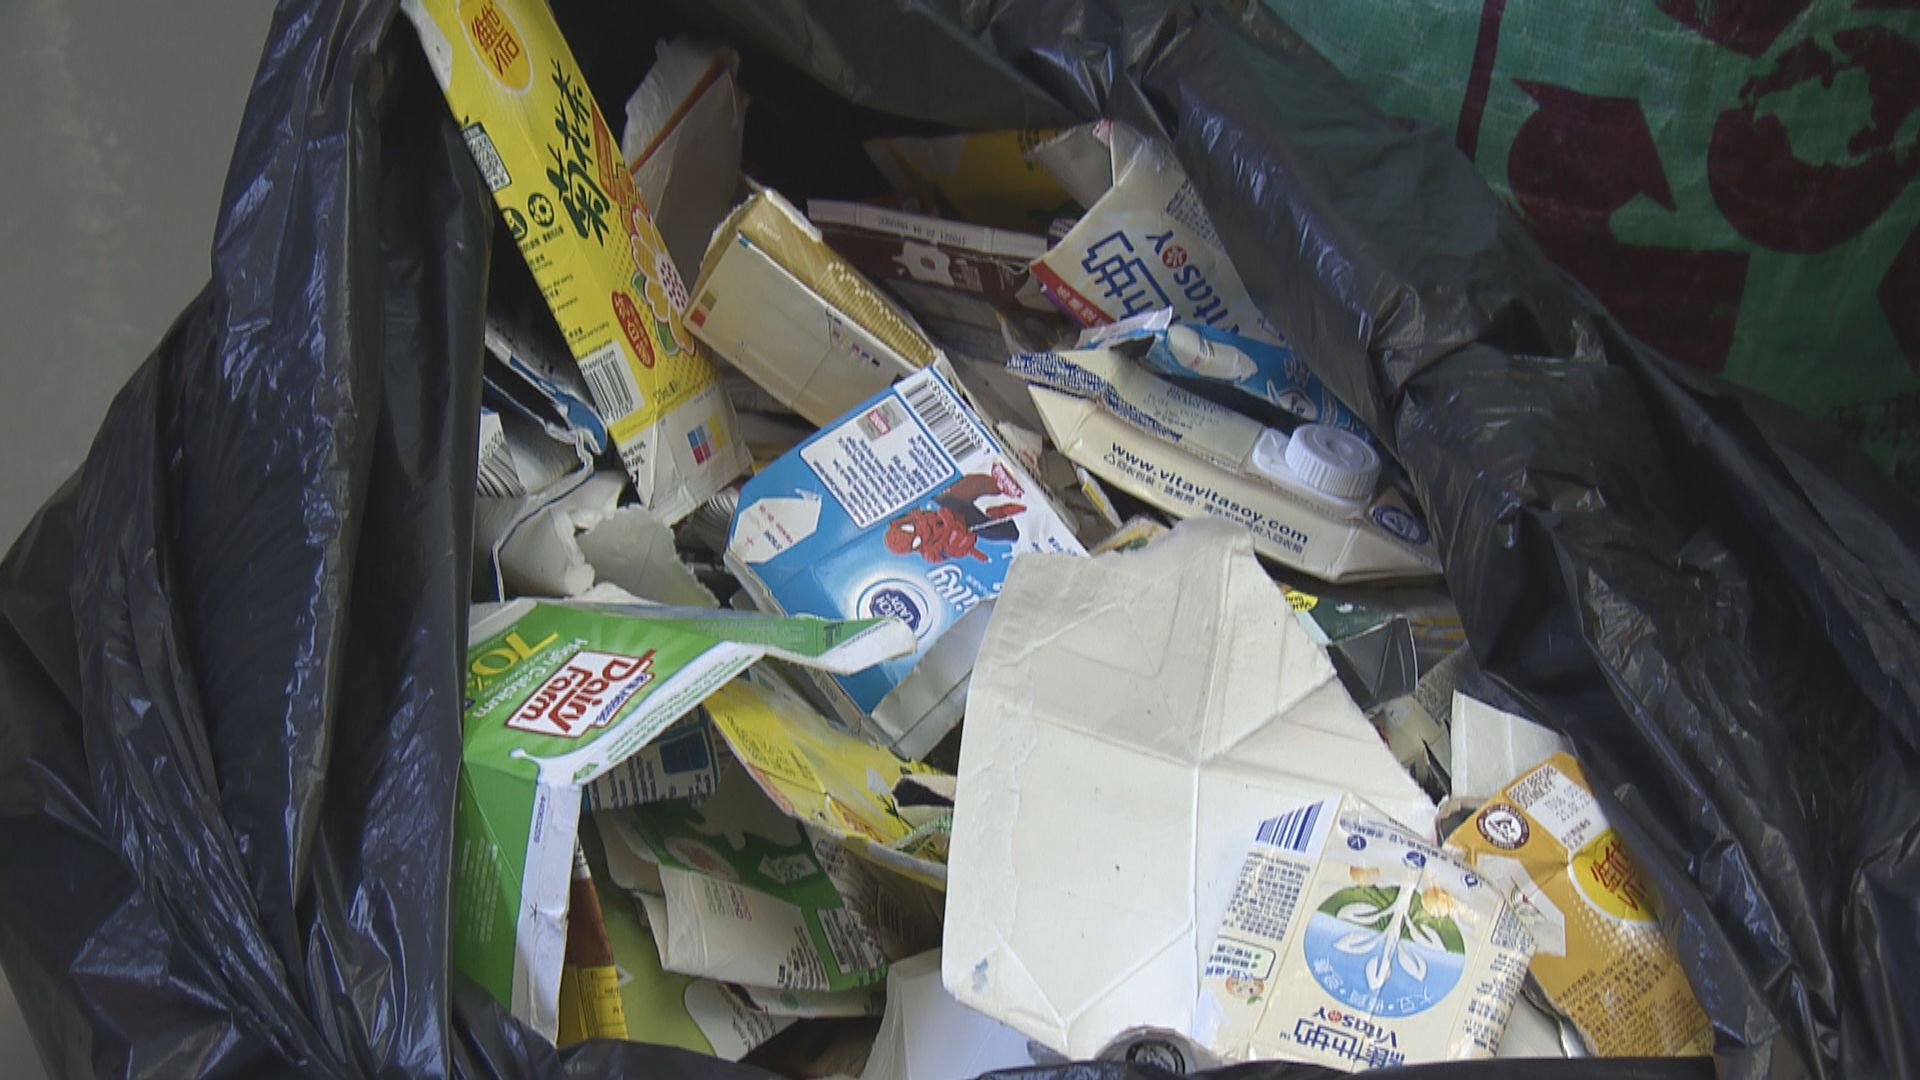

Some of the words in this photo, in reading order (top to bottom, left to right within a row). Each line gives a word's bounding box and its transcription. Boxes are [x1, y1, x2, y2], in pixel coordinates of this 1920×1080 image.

[471, 5, 520, 77] 維他
[546, 58, 610, 248] 菊花茶
[520, 665, 593, 721] Farm
[548, 648, 656, 733] Dairy
